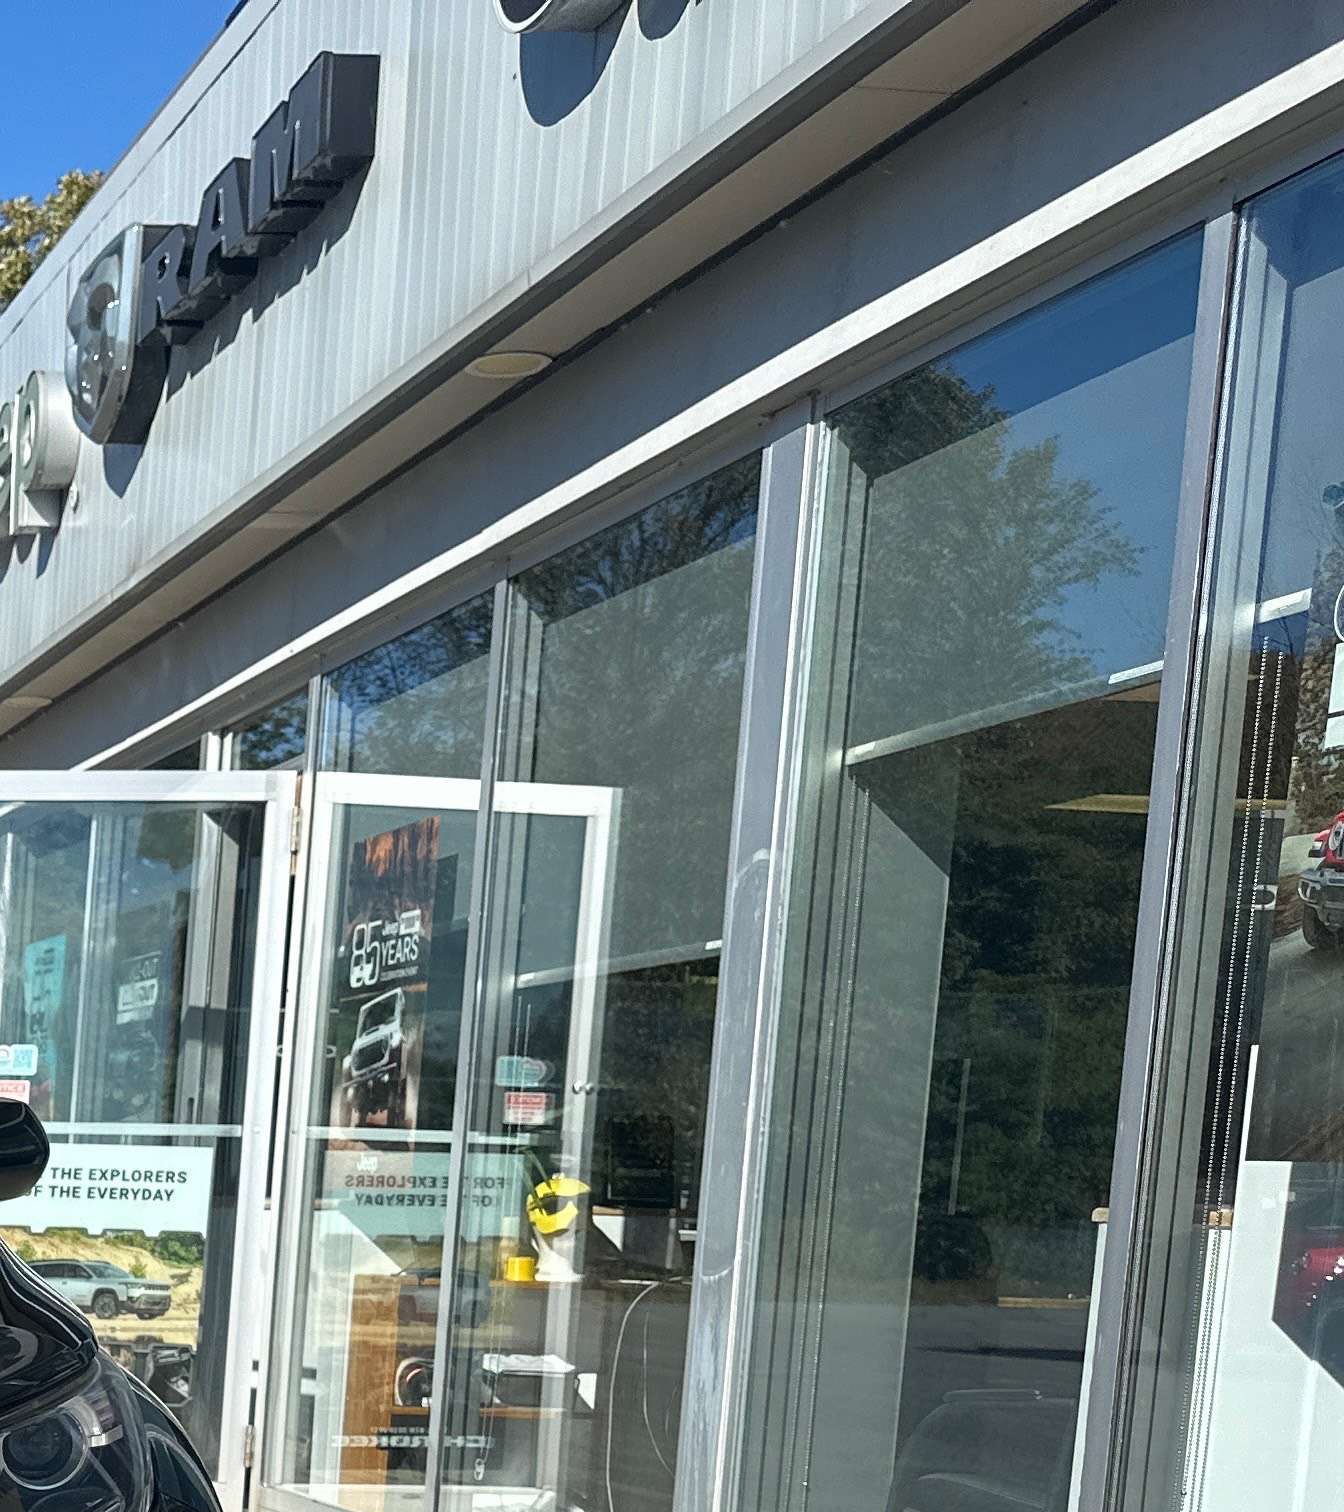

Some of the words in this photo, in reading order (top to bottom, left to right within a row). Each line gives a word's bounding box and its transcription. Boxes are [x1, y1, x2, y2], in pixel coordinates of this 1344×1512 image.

[135, 52, 336, 346] RAM
[381, 934, 420, 967] YEARS
[50, 1167, 83, 1181] THE
[88, 1168, 188, 1184] EXPLORERS
[49, 1185, 81, 1199] THE
[87, 1186, 175, 1202] EVERYDAY
